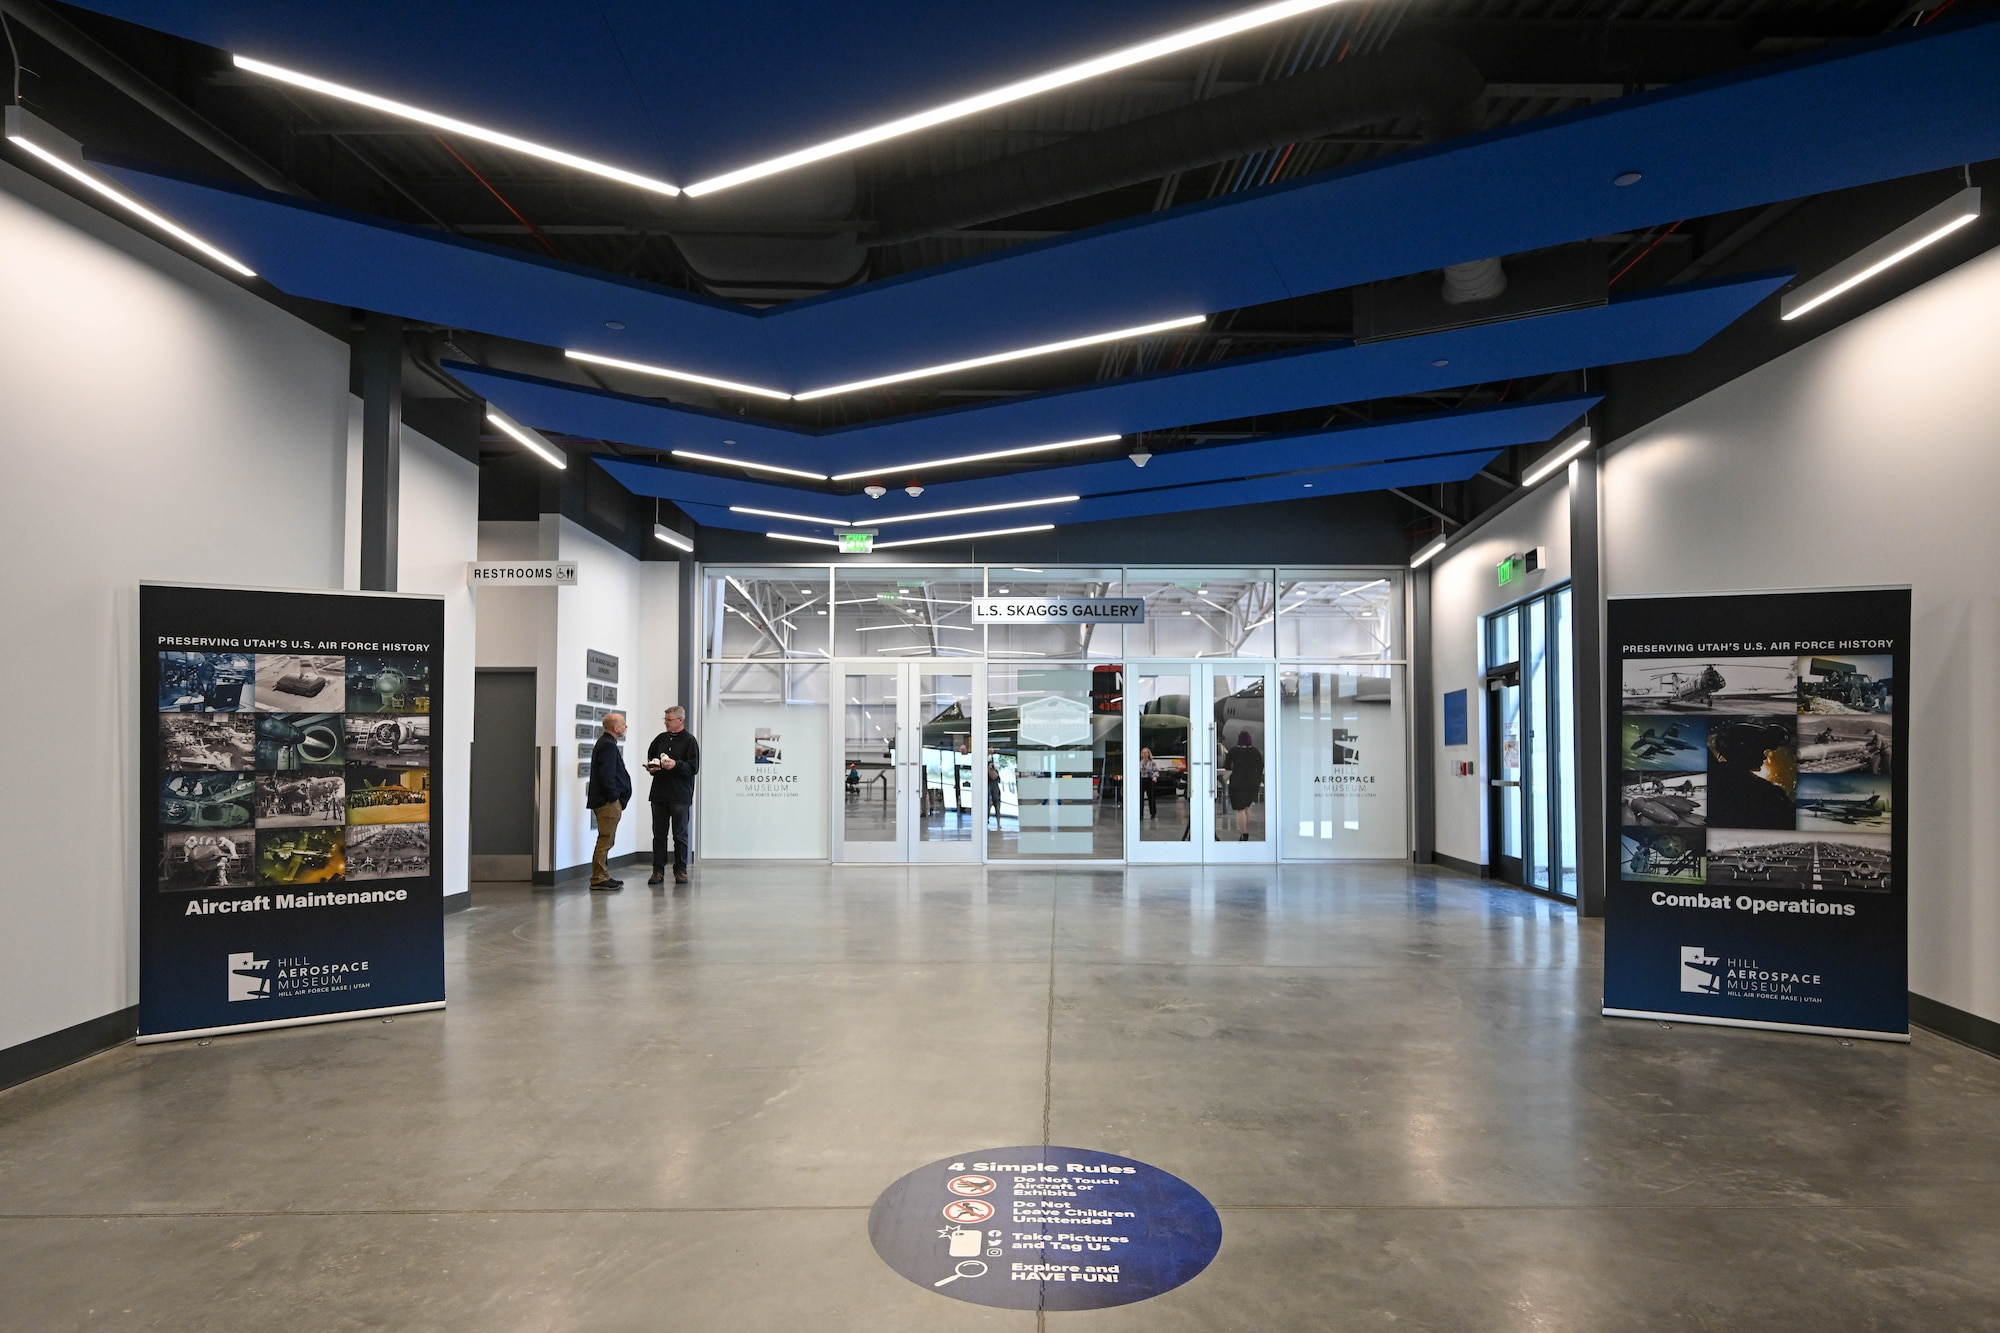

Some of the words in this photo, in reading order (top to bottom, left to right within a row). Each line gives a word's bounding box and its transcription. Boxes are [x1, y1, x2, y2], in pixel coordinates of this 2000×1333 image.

[846, 534, 867, 550] EXIT
[474, 568, 553, 578] RESTROOMS
[977, 605, 1002, 616] L.S.
[1007, 605, 1068, 616] SKAGGS
[1072, 605, 1139, 616] GALLERY
[158, 636, 239, 647] PRESERVING
[243, 639, 287, 648] UTAH'S
[291, 640, 314, 649] U.S.
[318, 641, 338, 650] AIR
[341, 642, 379, 650] FORCE
[382, 643, 430, 652] HISTORY
[1622, 644, 1694, 653] PRESERVING
[1698, 642, 1740, 652] UTAH'S
[1744, 642, 1766, 650] U.S.
[1770, 642, 1790, 650] AIR
[1795, 641, 1835, 650] FORCE
[1840, 640, 1893, 648] HISTORY
[185, 895, 270, 916] Aircraft
[276, 888, 408, 910] Maintenance
[1651, 891, 1731, 910] Combat
[1736, 896, 1856, 916] Operations
[278, 956, 310, 967] HILL
[1727, 958, 1759, 969] HILL
[278, 961, 369, 978] AEROSPACE
[1727, 969, 1821, 984] AEROSPACE
[278, 975, 342, 990] MUSEUM
[1727, 980, 1792, 993] MUSEUM
[308, 987, 329, 995] FORCE
[948, 1162, 965, 1171] 4
[972, 1162, 1059, 1174] Simple
[1066, 1163, 1136, 1174] Rules
[1065, 1209, 1135, 1217] Children
[1013, 1216, 1112, 1225] Unattended
[1012, 1233, 1053, 1241] Take
[1058, 1234, 1129, 1243] Pictures
[1050, 1242, 1082, 1252] Tag
[1087, 1243, 1111, 1251] Us
[1012, 1263, 1080, 1272] Explore
[1085, 1265, 1120, 1273] and
[1012, 1272, 1066, 1281] HAVE
[1071, 1273, 1119, 1282] FUN!
